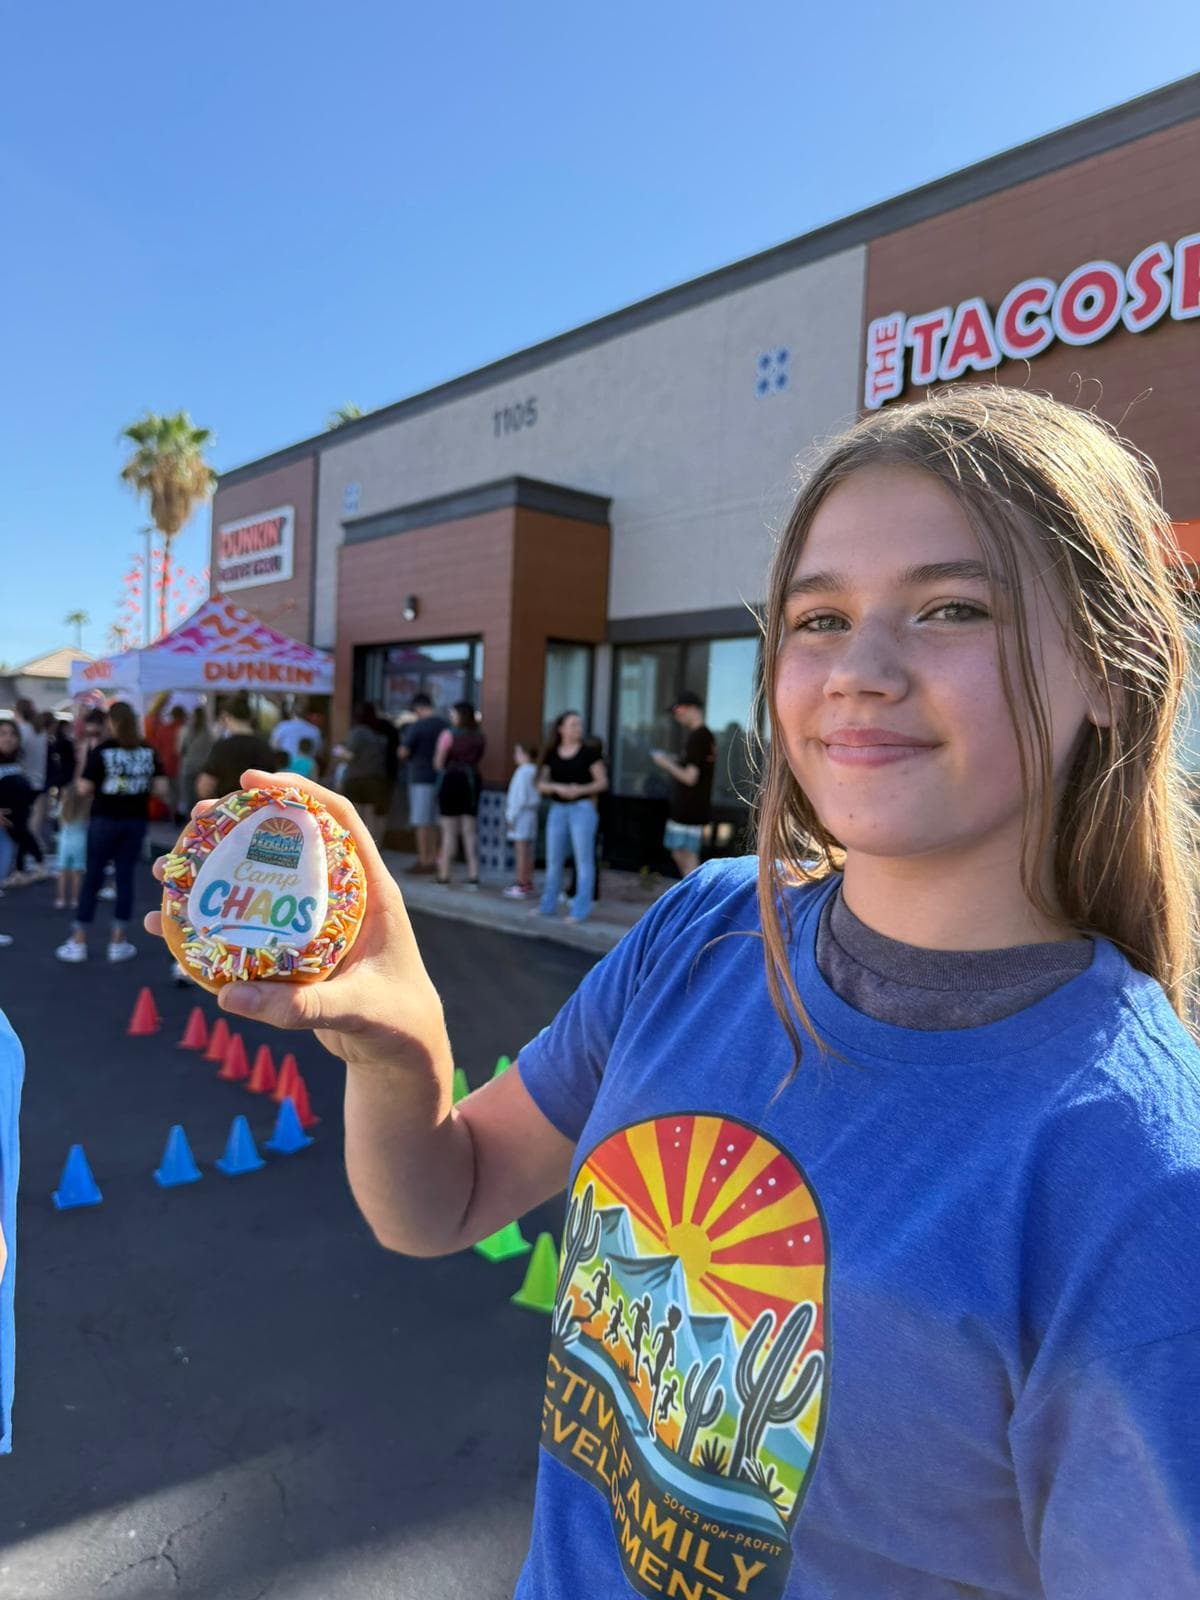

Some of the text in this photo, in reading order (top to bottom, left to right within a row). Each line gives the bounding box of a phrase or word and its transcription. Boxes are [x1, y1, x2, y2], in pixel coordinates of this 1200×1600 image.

[868, 314, 904, 406] THE
[494, 397, 539, 438] 1105
[233, 861, 299, 890] Camp
[199, 880, 317, 933] CHAOS
[618, 1446, 767, 1594] FAMILY
[701, 1521, 782, 1556] NON-PROFIT
